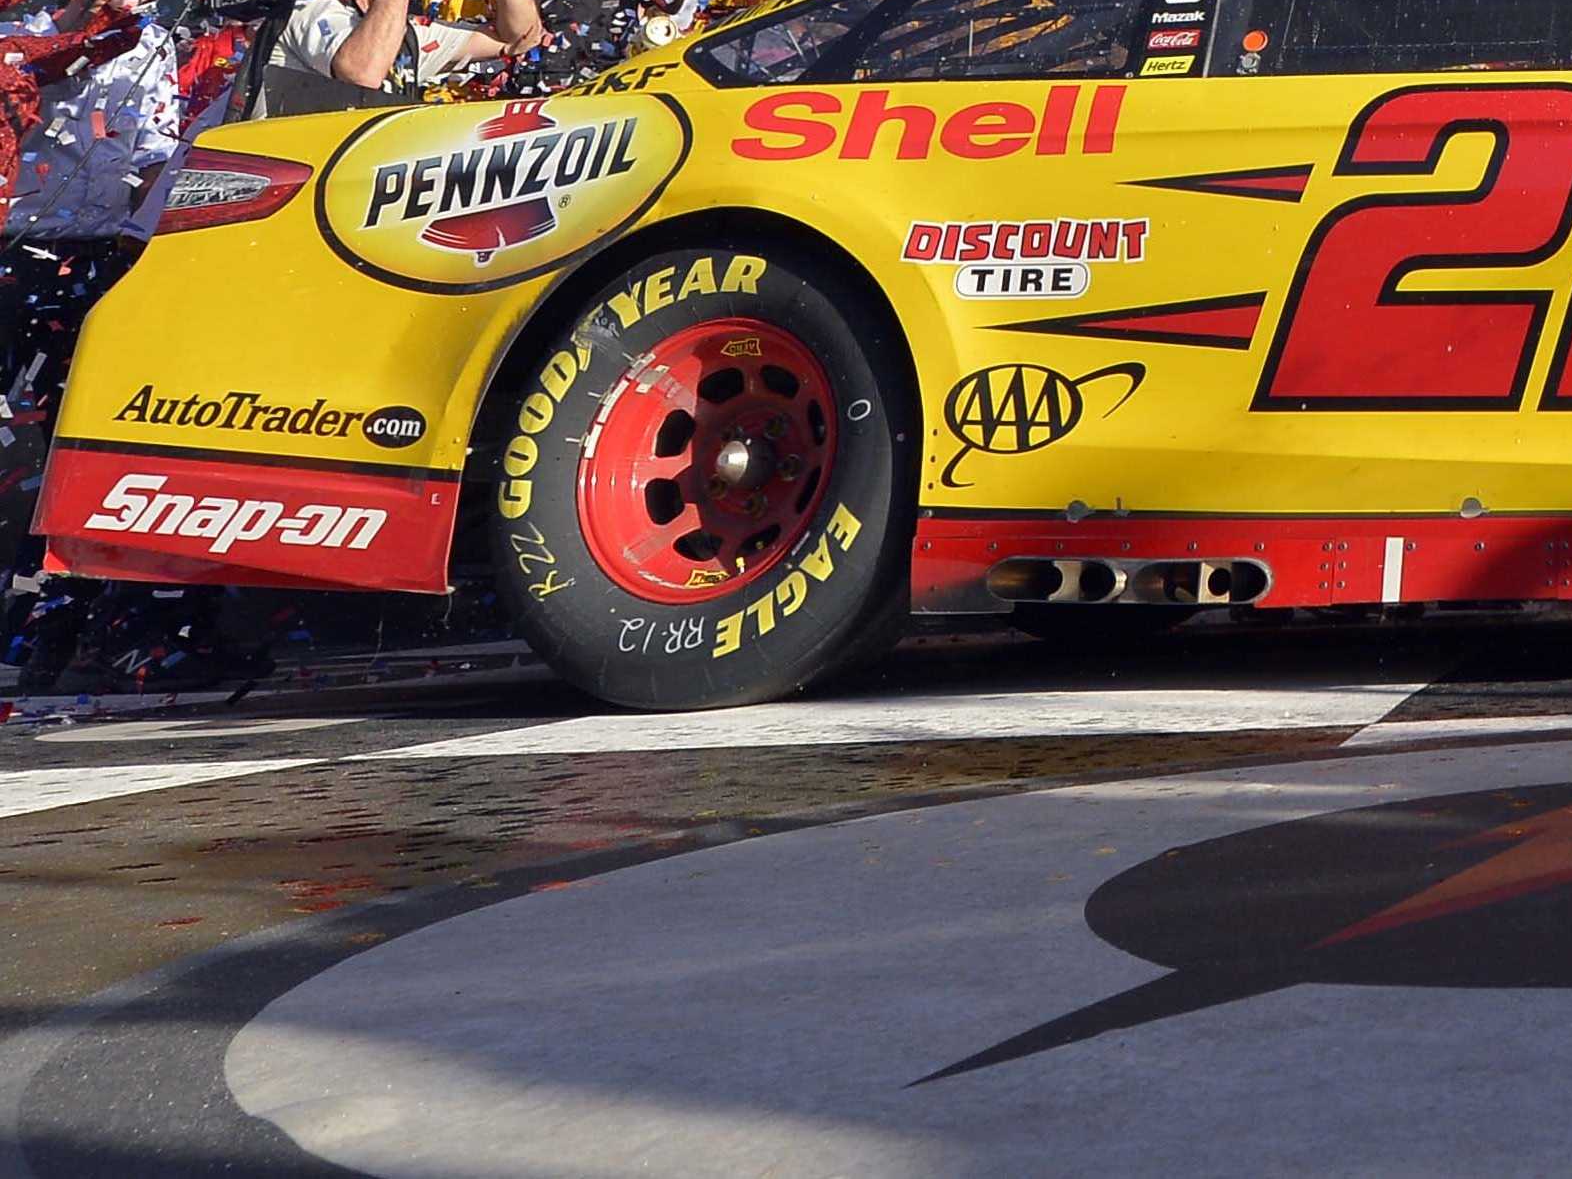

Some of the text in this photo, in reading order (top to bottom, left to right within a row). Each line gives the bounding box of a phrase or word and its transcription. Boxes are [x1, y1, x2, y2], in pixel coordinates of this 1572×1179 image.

[1152, 10, 1205, 24] Mazak
[1147, 61, 1186, 72] Hertz
[731, 85, 1128, 161] Shell
[364, 118, 639, 227] PENNZOIL
[903, 220, 1147, 261] DISCOUNT
[971, 269, 1073, 292] TIRE
[114, 385, 422, 439] AutoTrader.com
[500, 255, 767, 519] GOODYEAR
[957, 367, 1064, 450] AAA
[85, 474, 387, 553] Snap-on
[712, 503, 862, 657] EAGLE
